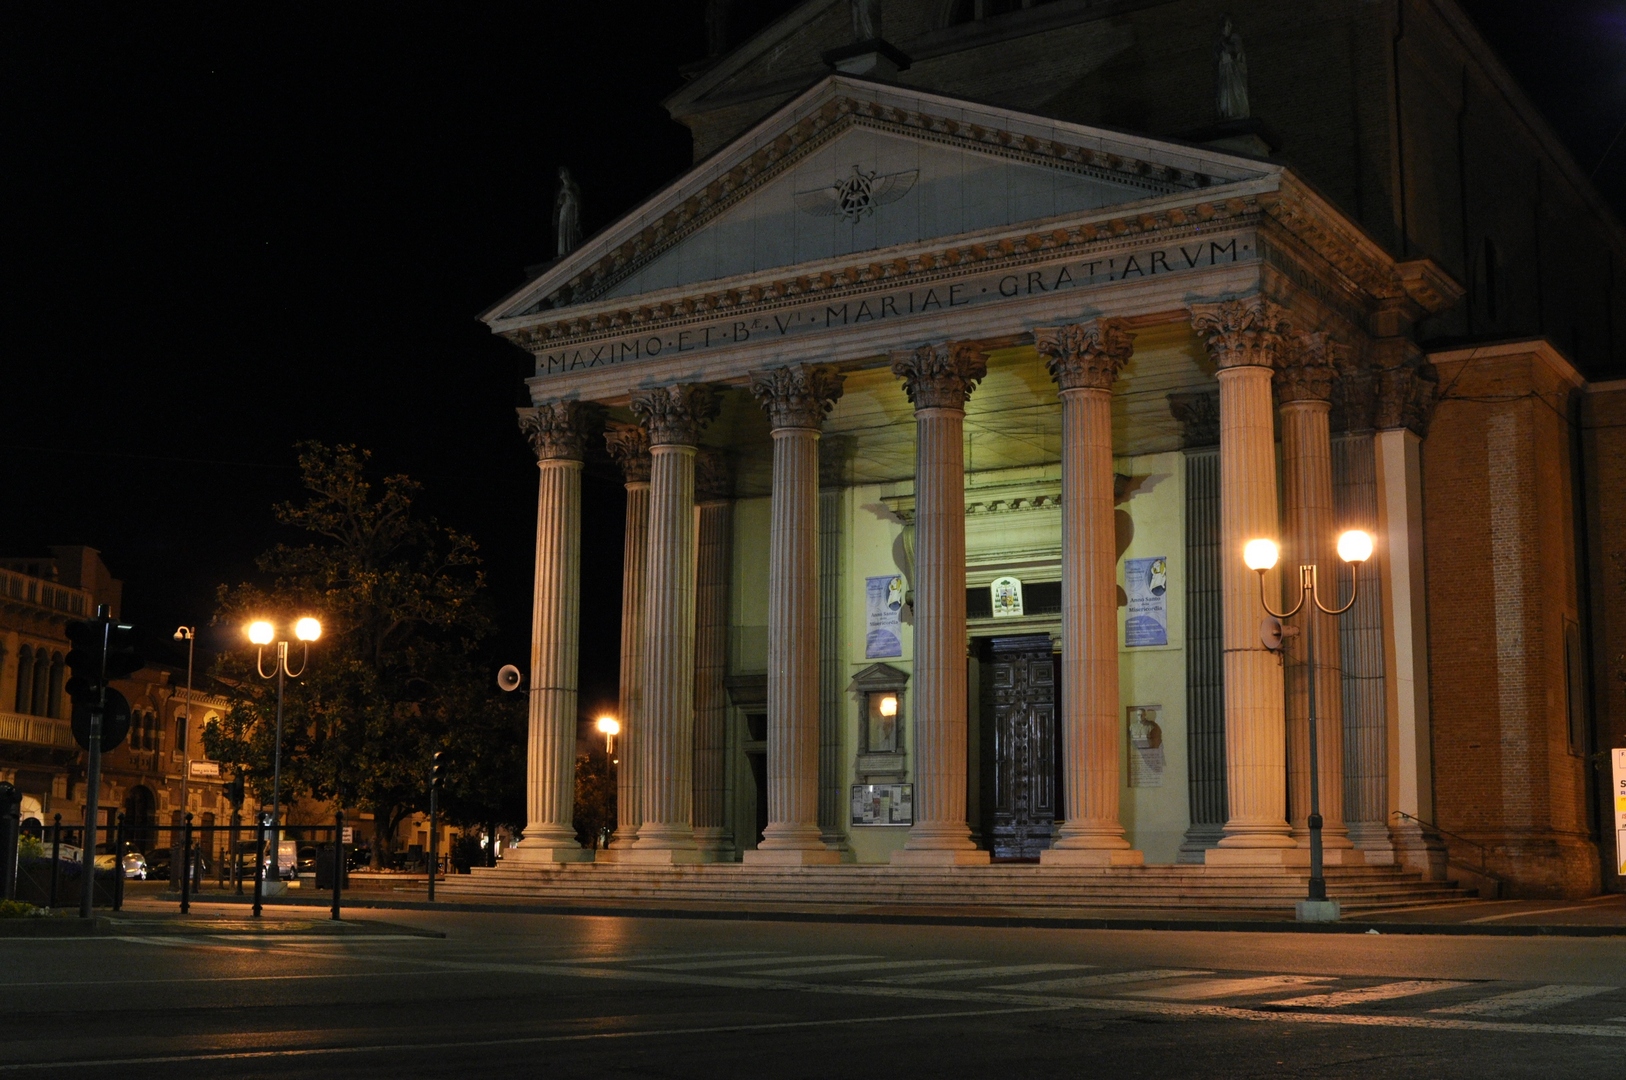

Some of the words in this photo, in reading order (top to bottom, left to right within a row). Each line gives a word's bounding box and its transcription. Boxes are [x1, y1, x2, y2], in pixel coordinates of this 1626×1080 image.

[547, 336, 663, 375] MAXIMO
[678, 326, 716, 352] ET
[825, 282, 970, 328] MARIAE
[998, 238, 1238, 297] GRATIARVM
